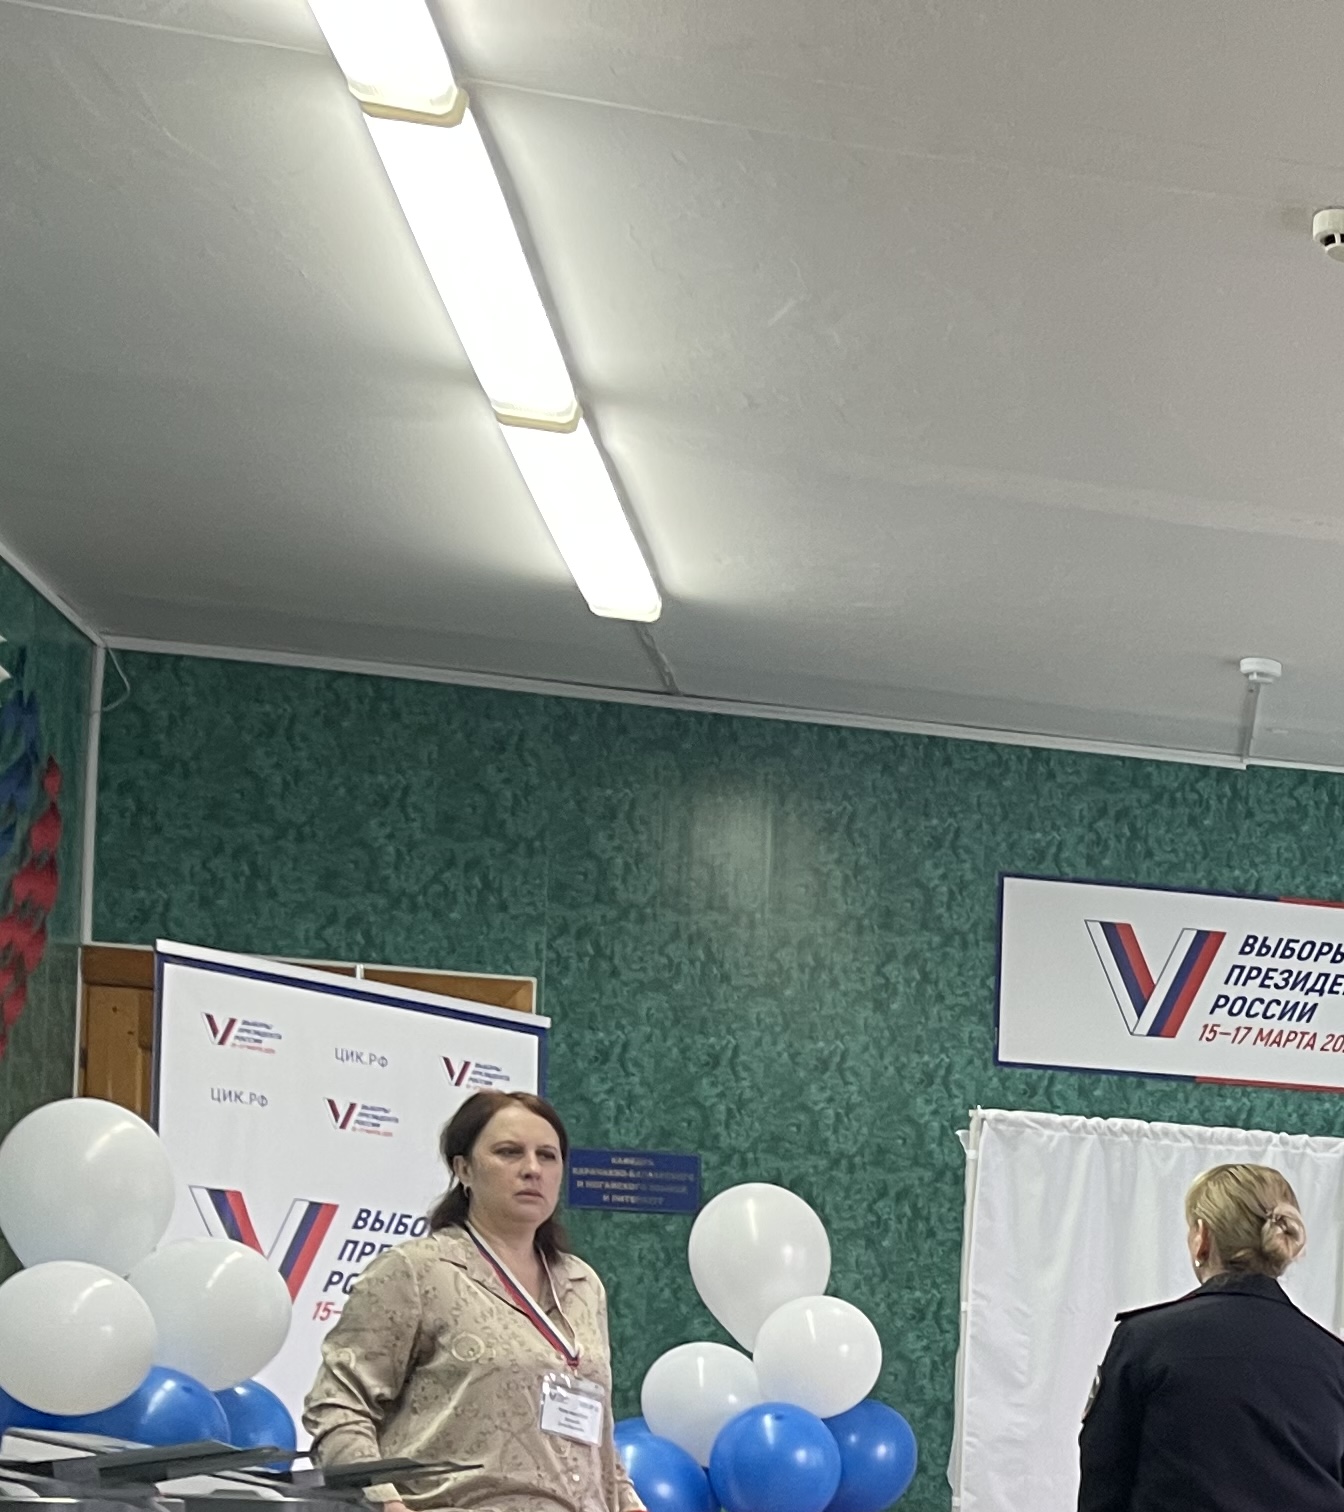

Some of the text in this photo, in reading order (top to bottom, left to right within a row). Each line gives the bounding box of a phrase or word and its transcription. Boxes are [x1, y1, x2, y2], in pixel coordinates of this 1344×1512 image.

[1209, 993, 1319, 1023] РОССИИ
[1252, 1027, 1318, 1051] МАРТА
[334, 1047, 388, 1068] ЦИК.РФ
[210, 1087, 268, 1107] ЦИК.РФ
[351, 1208, 430, 1238] ВЫБО
